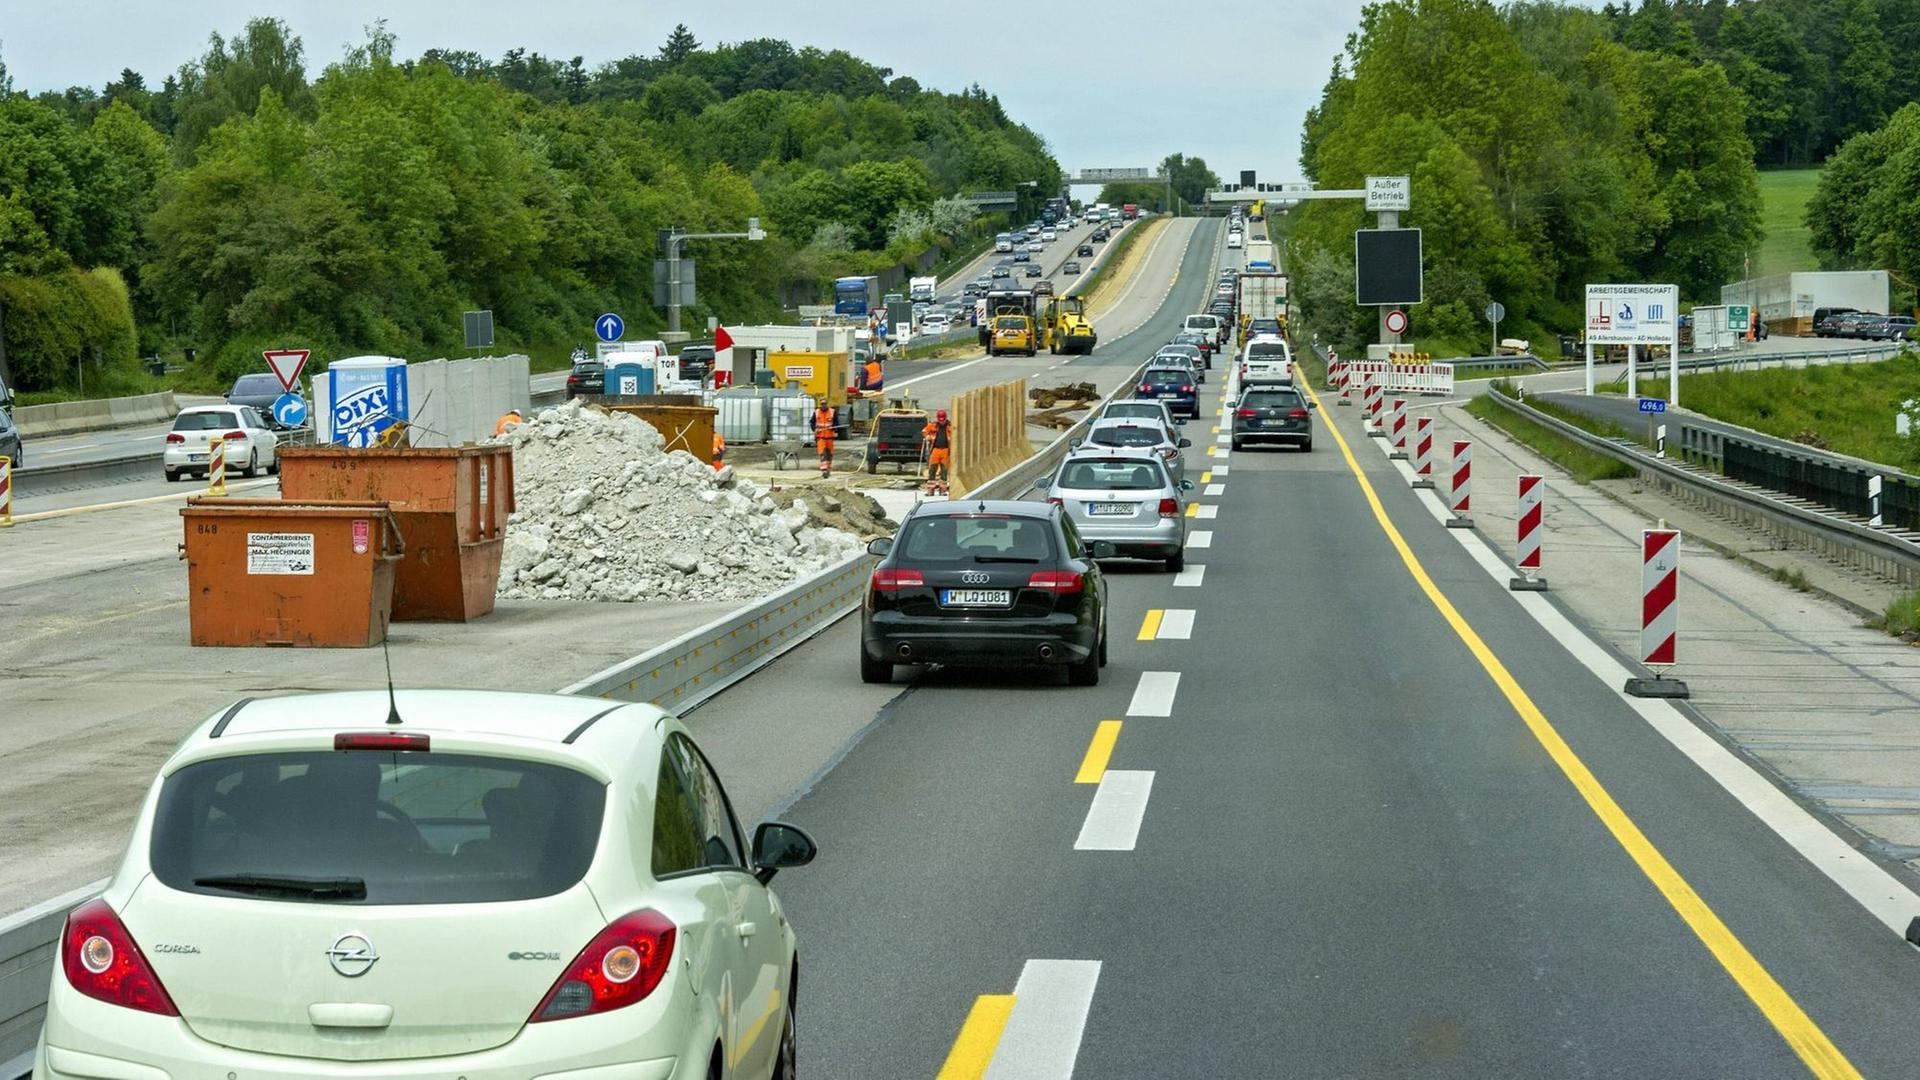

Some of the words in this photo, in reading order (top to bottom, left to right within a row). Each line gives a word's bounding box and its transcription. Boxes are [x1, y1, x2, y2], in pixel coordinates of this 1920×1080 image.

[1374, 180, 1401, 189] Außer
[1371, 191, 1404, 200] Betrieb
[661, 360, 676, 368] TOR
[666, 372, 671, 380] 4
[331, 460, 357, 470] 409
[197, 524, 218, 535] 848
[154, 944, 201, 954] CORSA
